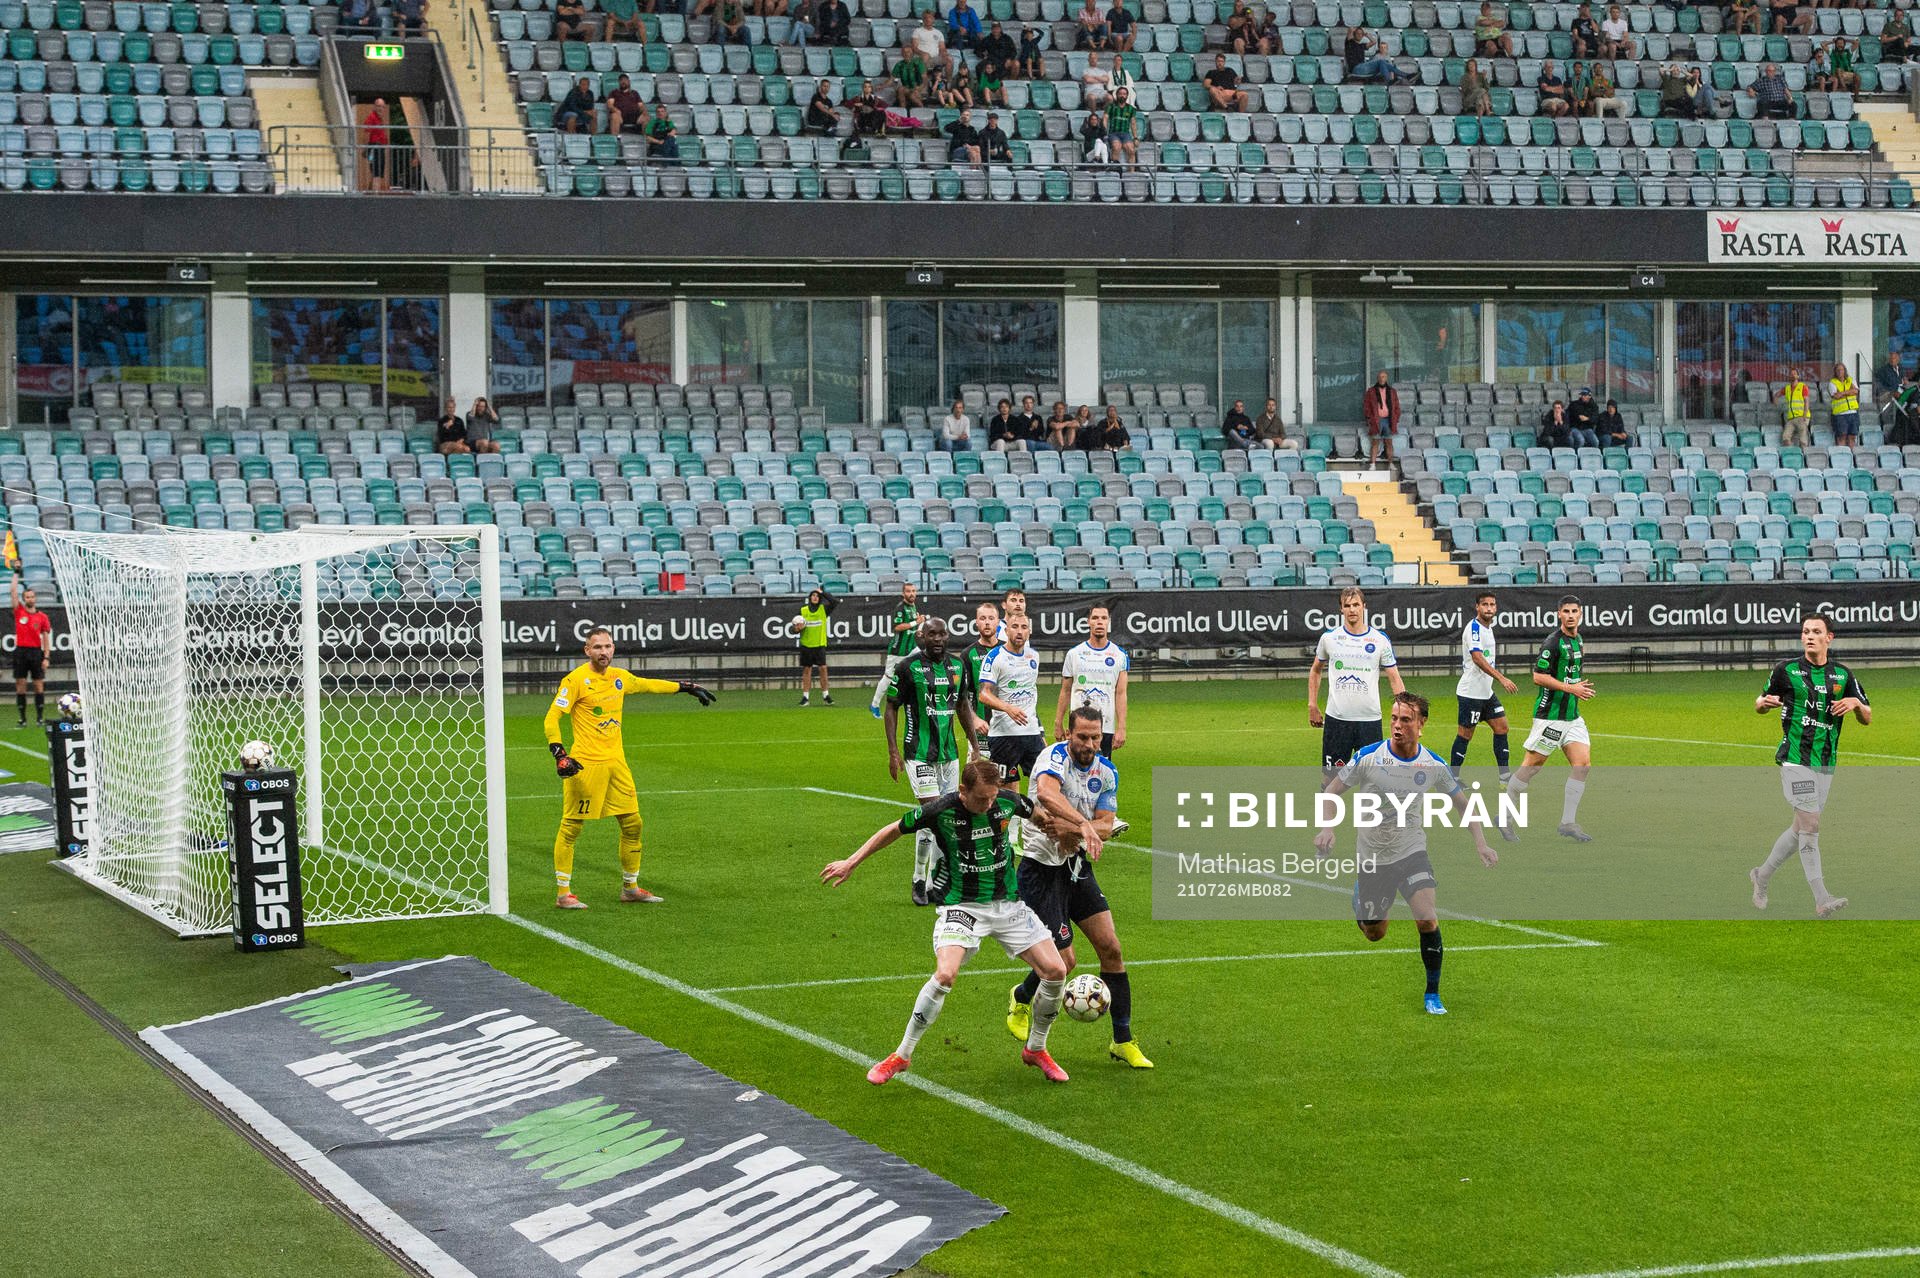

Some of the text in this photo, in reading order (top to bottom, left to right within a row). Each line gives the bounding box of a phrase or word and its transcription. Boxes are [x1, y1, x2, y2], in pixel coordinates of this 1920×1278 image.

[1720, 232, 1908, 256] RASTA RASTA
[180, 269, 195, 279] C2
[917, 273, 931, 283] C3
[1641, 276, 1655, 286] C4
[2, 626, 72, 651] ala
[283, 622, 362, 648] Uevi
[380, 621, 471, 645] Gamla
[479, 620, 556, 644] llevi
[670, 617, 746, 641] Ullevi
[762, 616, 850, 640] Gala
[1126, 611, 1210, 634] Gamla
[1217, 609, 1289, 632] Ullevi
[1304, 608, 1386, 631] Gala
[1394, 607, 1462, 630] Ullevi
[1490, 605, 1559, 629] amla
[1580, 604, 1633, 627] llevi
[1648, 604, 1727, 627] Gamla
[1734, 602, 1800, 625] Ullevi
[1564, 665, 1582, 673] NEV
[924, 692, 959, 703] NEVS
[1470, 710, 1481, 724] 13
[261, 779, 290, 789] OBOS
[578, 799, 590, 815] 22
[993, 807, 1012, 819] SALDO
[250, 798, 291, 930] SELECT
[949, 909, 974, 925] VIRTUAL
[269, 933, 298, 944] OBOS
